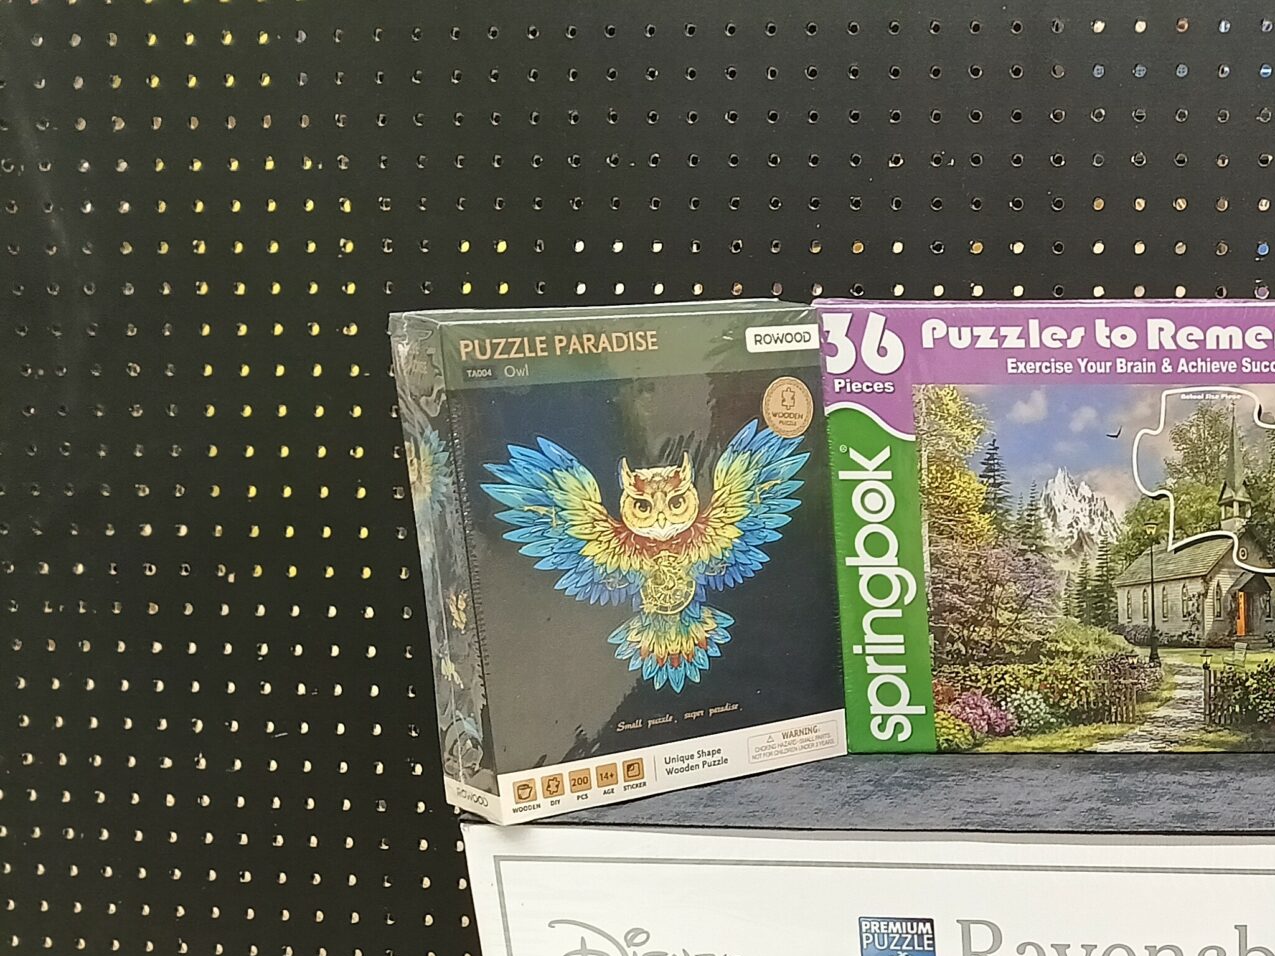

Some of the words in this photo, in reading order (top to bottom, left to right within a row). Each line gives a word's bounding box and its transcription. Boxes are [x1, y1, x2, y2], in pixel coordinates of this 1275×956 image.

[754, 331, 812, 346] ROWOOD
[921, 318, 1085, 349] Puzzles
[1096, 318, 1138, 348] to
[459, 335, 549, 361] PUZZLE
[554, 330, 659, 355] PARADISE
[821, 312, 905, 374] 36
[504, 364, 529, 377] Owl
[1007, 357, 1073, 374] Exercise
[1077, 357, 1113, 374] Your
[1116, 357, 1157, 374] Brain
[1161, 358, 1173, 373] &
[1178, 357, 1238, 374] Achieve
[834, 378, 895, 393] Pieces
[772, 411, 804, 421] WOODEN
[838, 445, 926, 742] springbok
[616, 719, 643, 732] Small
[684, 709, 705, 721] super
[664, 753, 695, 766] Unique
[696, 748, 722, 761] Shape
[665, 763, 700, 776] Wooden
[701, 757, 729, 770] Puzzle
[571, 776, 589, 788] 200
[599, 772, 615, 781] 14+
[602, 788, 615, 796] AGE
[623, 781, 647, 792] STICKER
[550, 799, 561, 807] DIY
[576, 793, 588, 801] PCS
[512, 803, 542, 814] WOODEN
[861, 920, 933, 935] PREMIUM
[862, 932, 934, 951] PUZZLE
